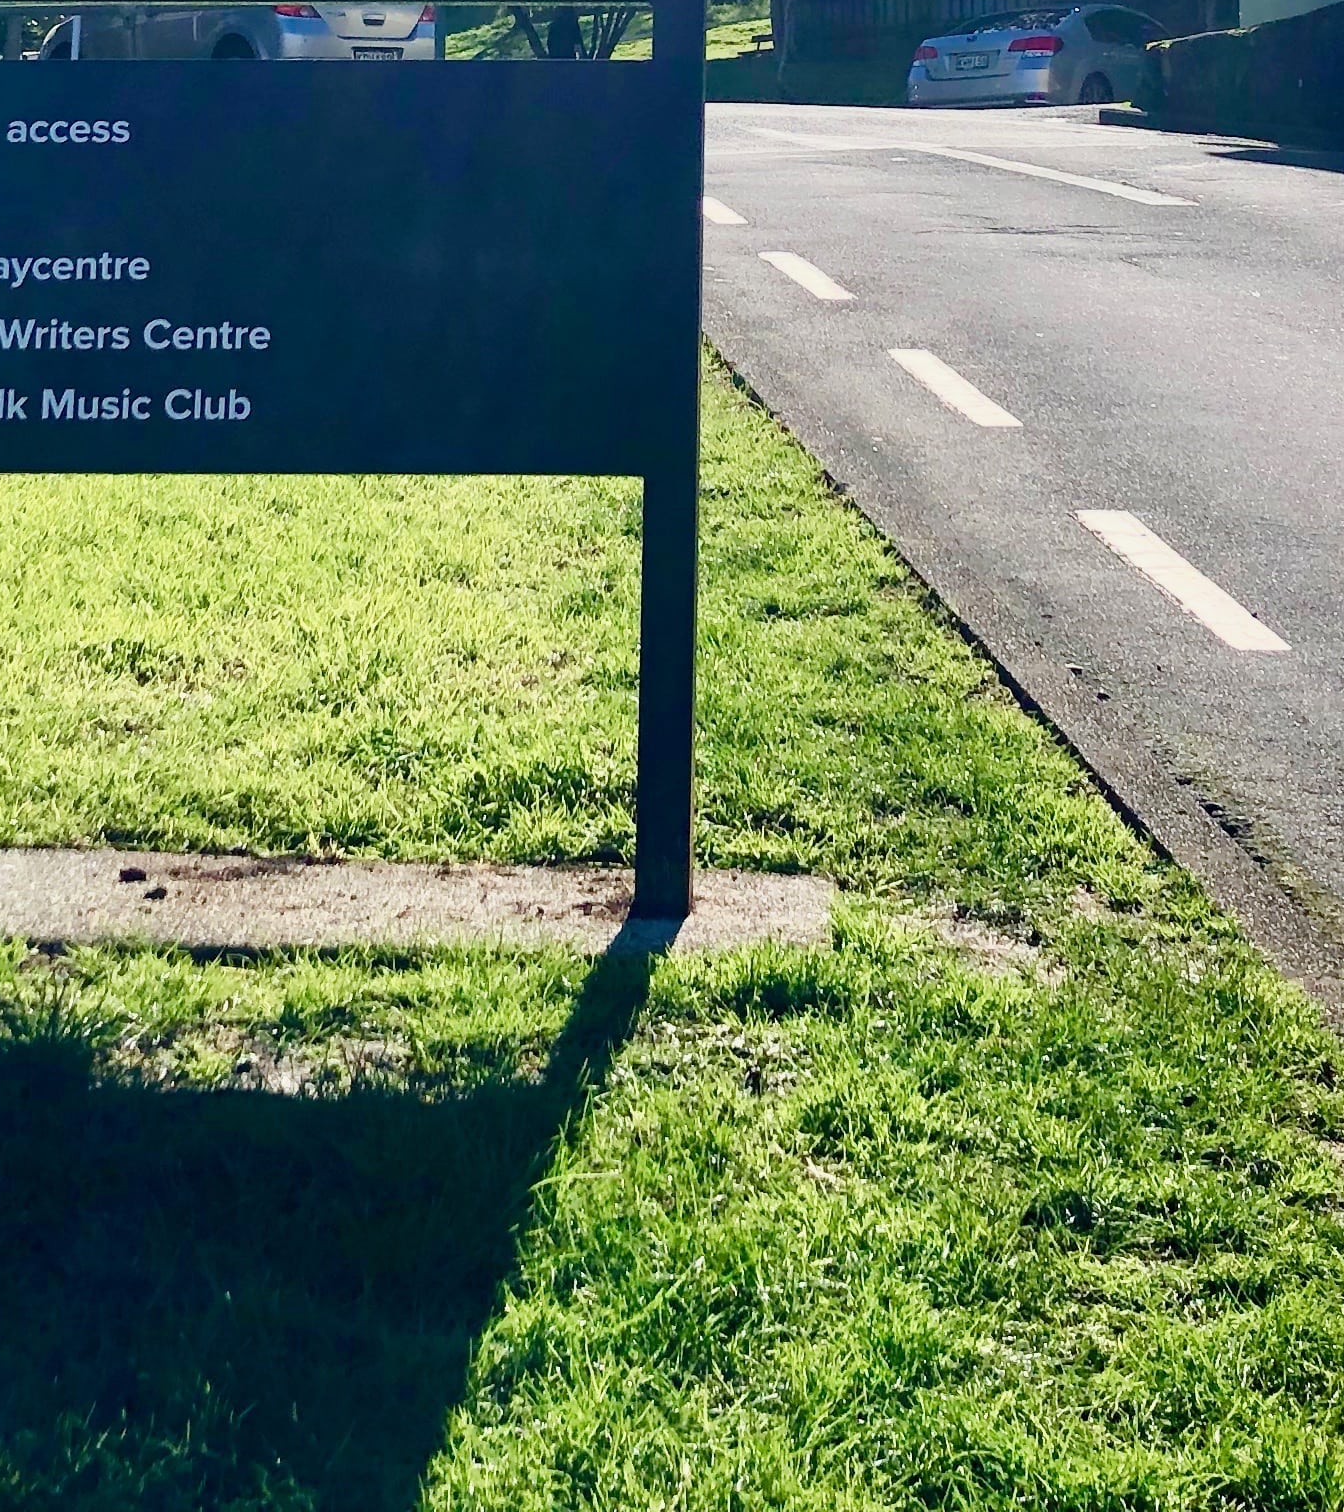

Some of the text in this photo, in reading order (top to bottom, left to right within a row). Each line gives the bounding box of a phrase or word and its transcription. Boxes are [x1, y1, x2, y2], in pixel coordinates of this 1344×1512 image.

[7, 121, 129, 142] access
[144, 319, 270, 349] Centre
[42, 388, 151, 419] Music
[165, 389, 250, 419] Club
